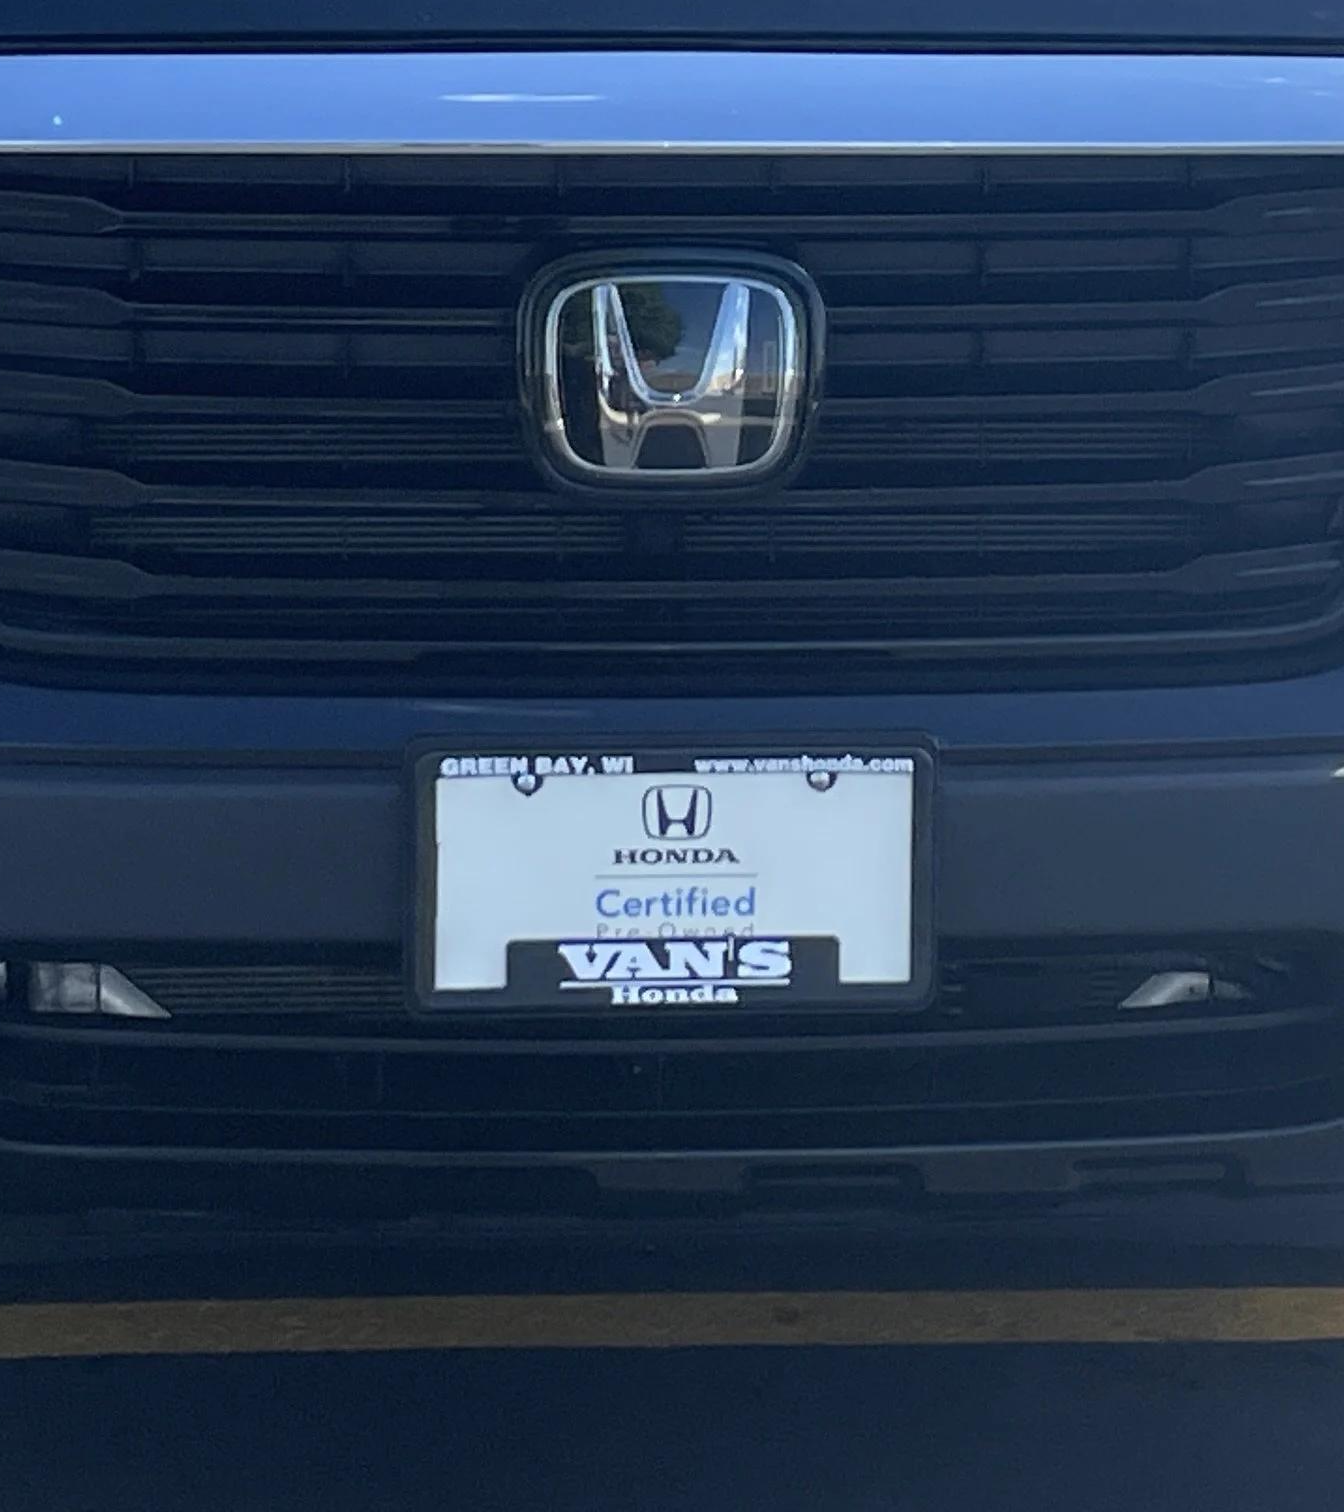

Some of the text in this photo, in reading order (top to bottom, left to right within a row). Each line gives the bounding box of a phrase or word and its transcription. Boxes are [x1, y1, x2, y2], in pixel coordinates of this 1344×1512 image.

[439, 756, 529, 776] GREEN
[601, 755, 634, 775] WI
[694, 754, 914, 773] www.vanshonda.com
[613, 849, 740, 865] HONDA
[595, 887, 756, 918] Certified
[596, 922, 755, 938] Pre-Owned
[558, 935, 793, 979] VAN'S
[611, 984, 739, 1005] Honda
